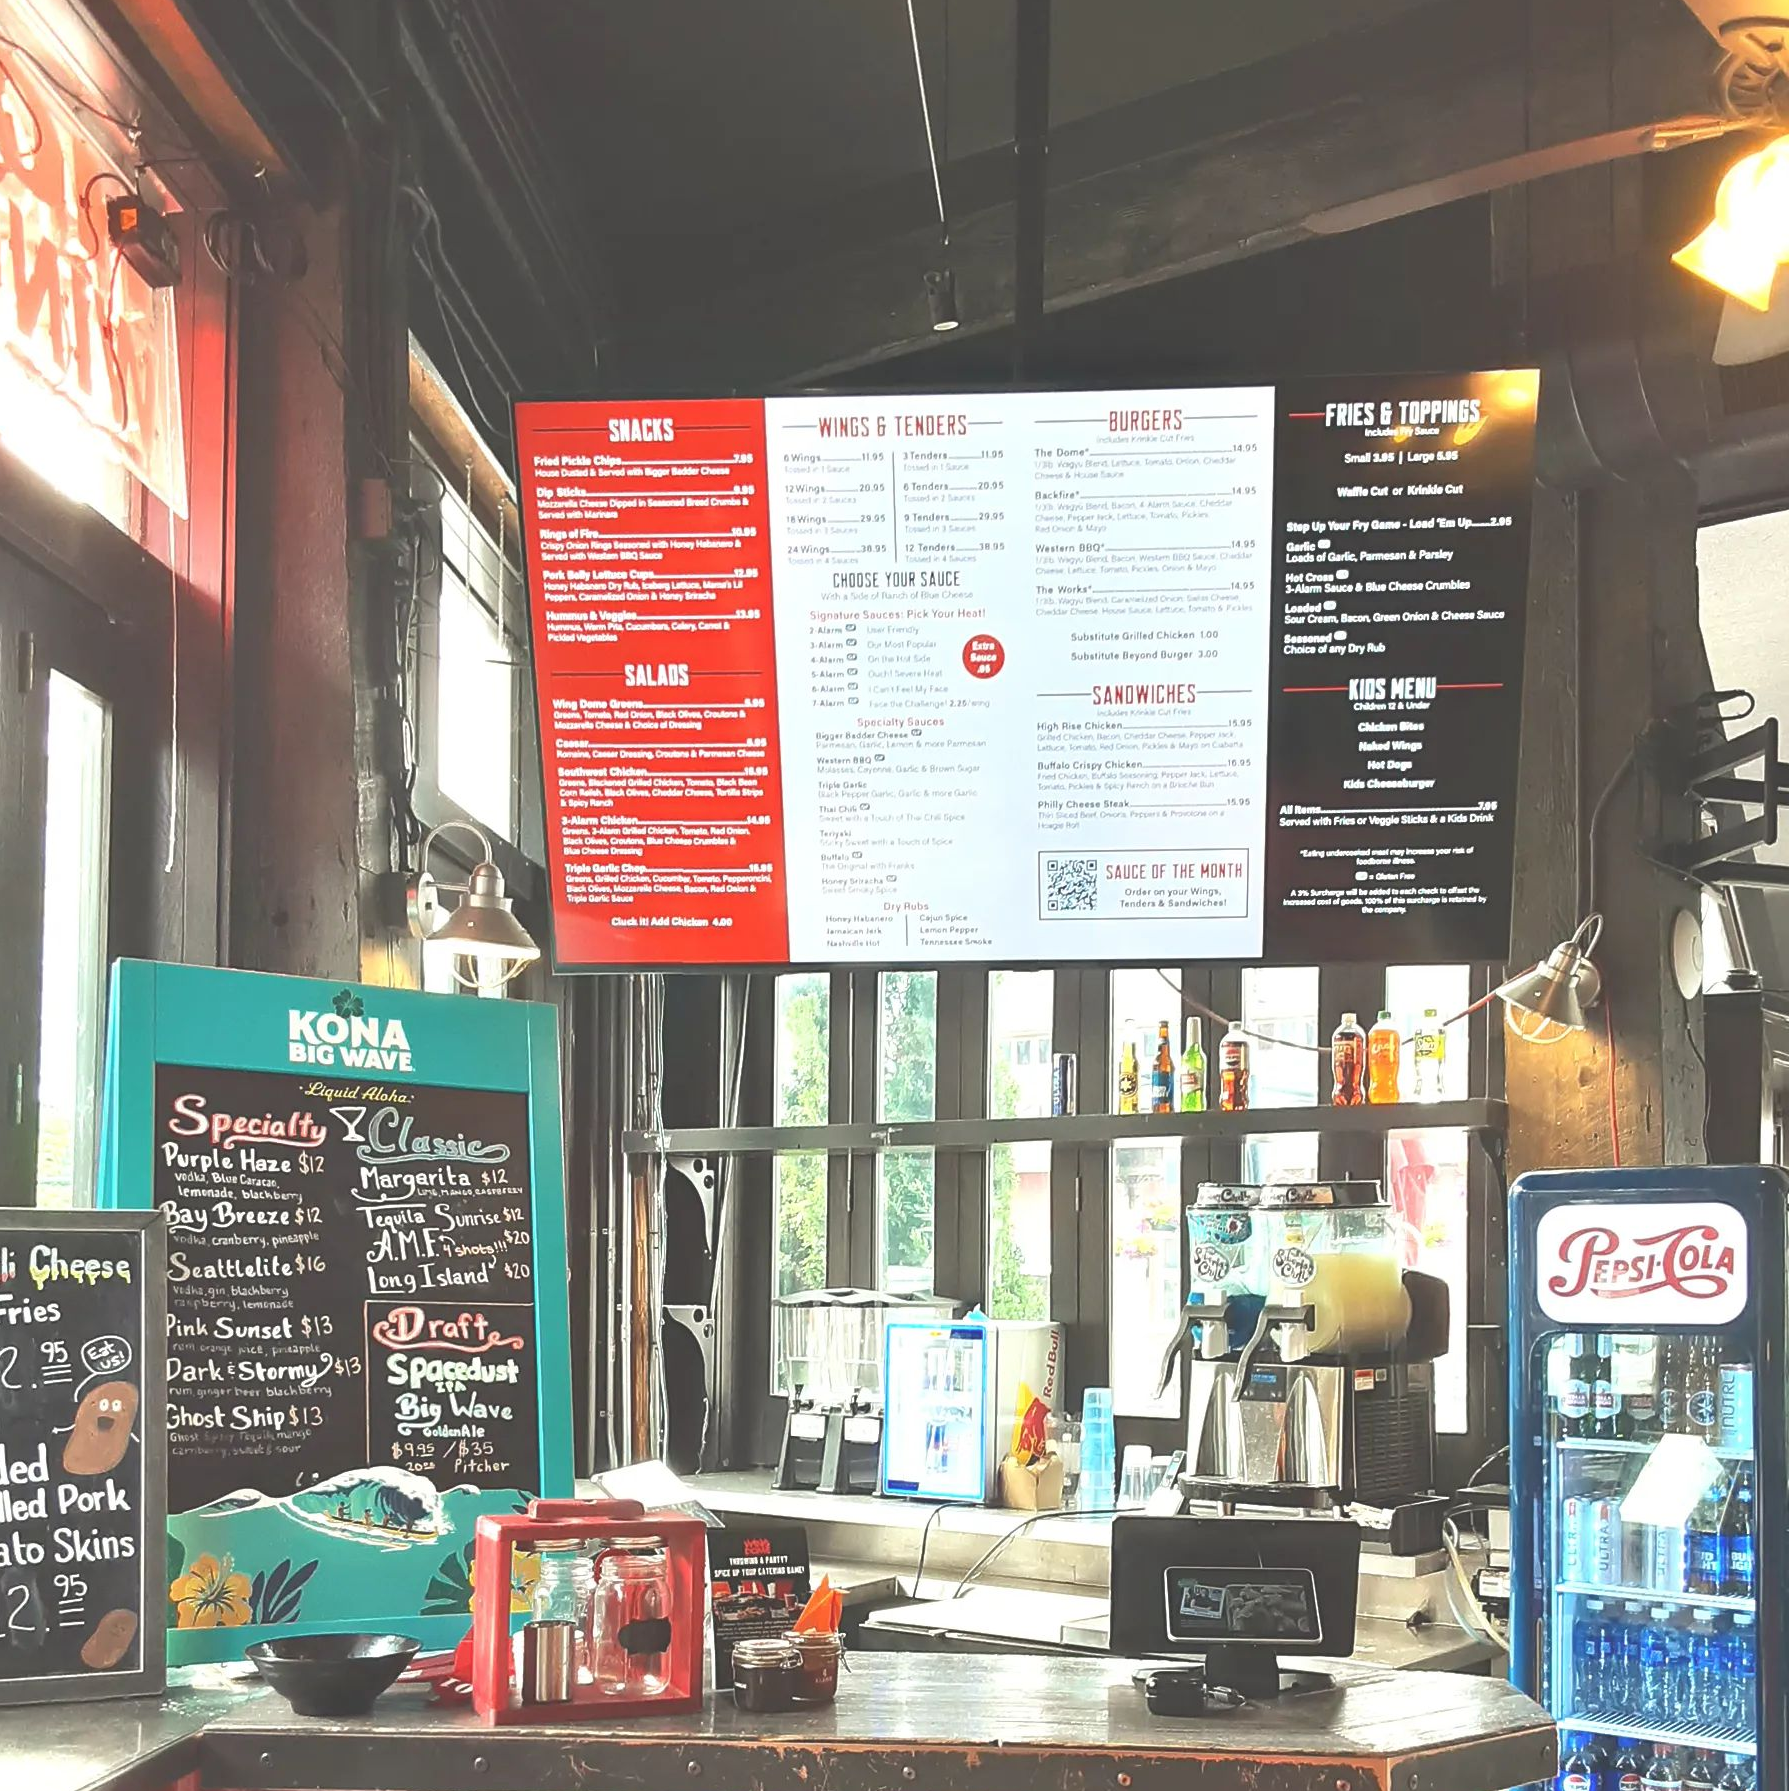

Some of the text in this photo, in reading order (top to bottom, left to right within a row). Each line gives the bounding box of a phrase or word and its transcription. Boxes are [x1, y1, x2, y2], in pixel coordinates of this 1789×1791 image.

[819, 415, 967, 437] WINGS & TENDERS
[1109, 409, 1182, 432] BURGERS
[1326, 399, 1480, 426] FRIES & TOPPINGS
[609, 418, 674, 442] SNACKS
[833, 571, 961, 588] CHOOSE YOUR SAUCE
[625, 664, 689, 686] SALADS
[1349, 677, 1437, 700] KIDS MENU
[1093, 684, 1196, 705] SANDWICHES
[1106, 863, 1242, 880] SAUCE OF THE MONTH
[289, 1009, 411, 1050] KONA
[289, 1042, 334, 1065] BIG
[305, 1082, 359, 1102] Liquid
[168, 1094, 327, 1150] Specialty
[358, 1106, 506, 1162] Classic
[161, 1142, 324, 1175] Purple Haze $12
[354, 1165, 508, 1199] Margarita $12
[242, 1190, 302, 1204] blackberry
[160, 1200, 322, 1233] Bay Breeze $12
[356, 1204, 524, 1233] Tequila Sunrise $12
[504, 1230, 529, 1245] $20
[30, 1245, 131, 1290] Cheese
[295, 1253, 326, 1274] $16
[367, 1263, 530, 1294] Long Island $20
[167, 1314, 333, 1339] Pink Sunset $13
[373, 1306, 499, 1348] Draft
[87, 1341, 125, 1369] Eat us!
[1043, 1330, 1059, 1397] Red Bull
[167, 1358, 224, 1382] Dark
[238, 1353, 333, 1388] Stormy
[334, 1356, 361, 1378] $13
[386, 1353, 519, 1389] Spacedust
[167, 1404, 323, 1430] Ghost Ship $13
[394, 1391, 513, 1427] Big Wave
[455, 1459, 509, 1473] Pitcher
[58, 1478, 131, 1514] Pork
[54, 1527, 134, 1563] Skins
